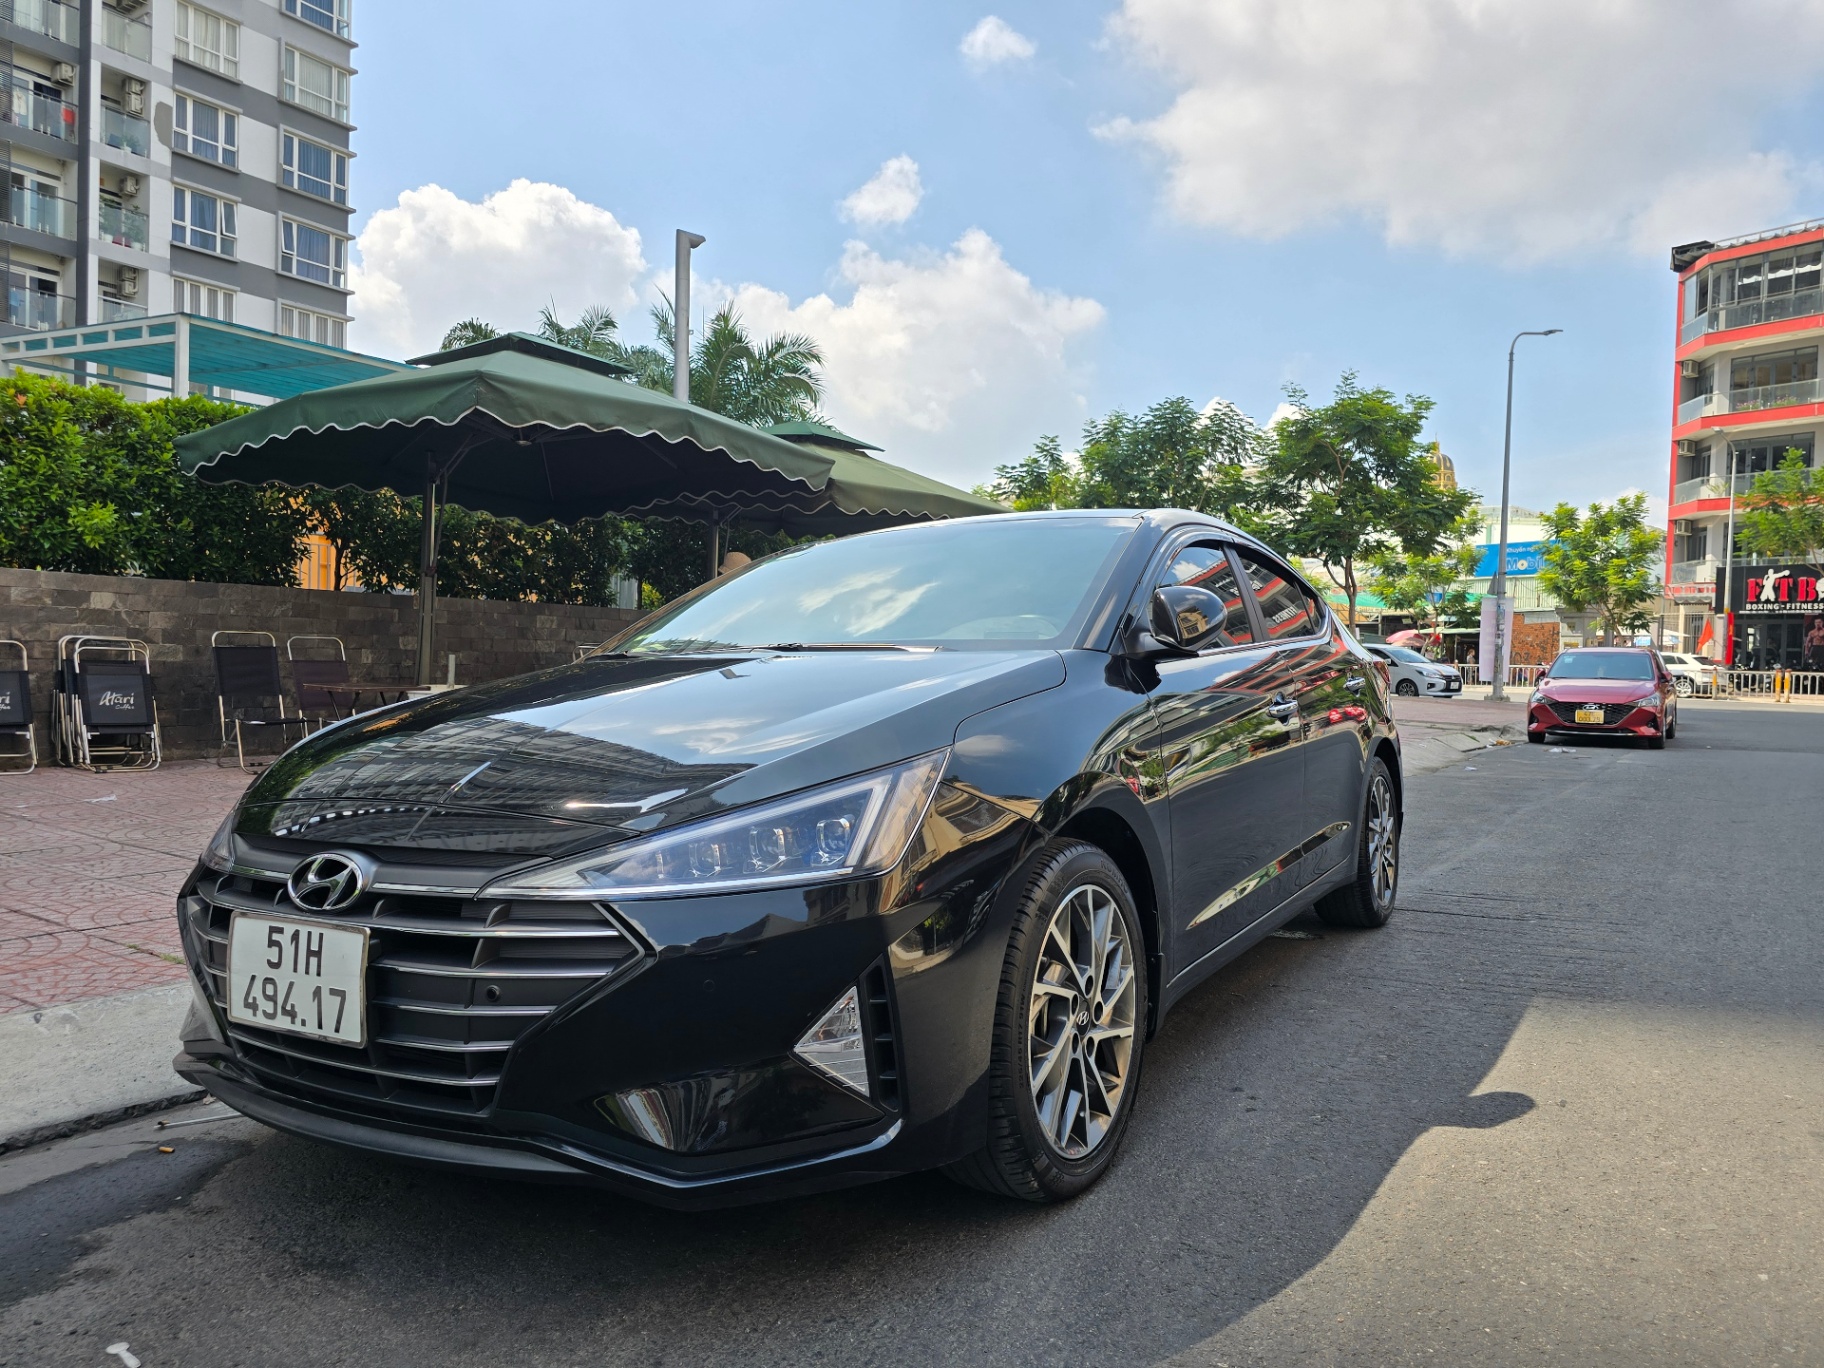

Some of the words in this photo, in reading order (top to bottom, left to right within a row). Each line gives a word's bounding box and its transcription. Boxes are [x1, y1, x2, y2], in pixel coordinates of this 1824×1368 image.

[1745, 602, 1780, 610] BOXING
[1786, 602, 1824, 610] FITNESS
[99, 690, 135, 706] Atari
[266, 925, 324, 977] 51H
[243, 974, 347, 1034] 494.17
